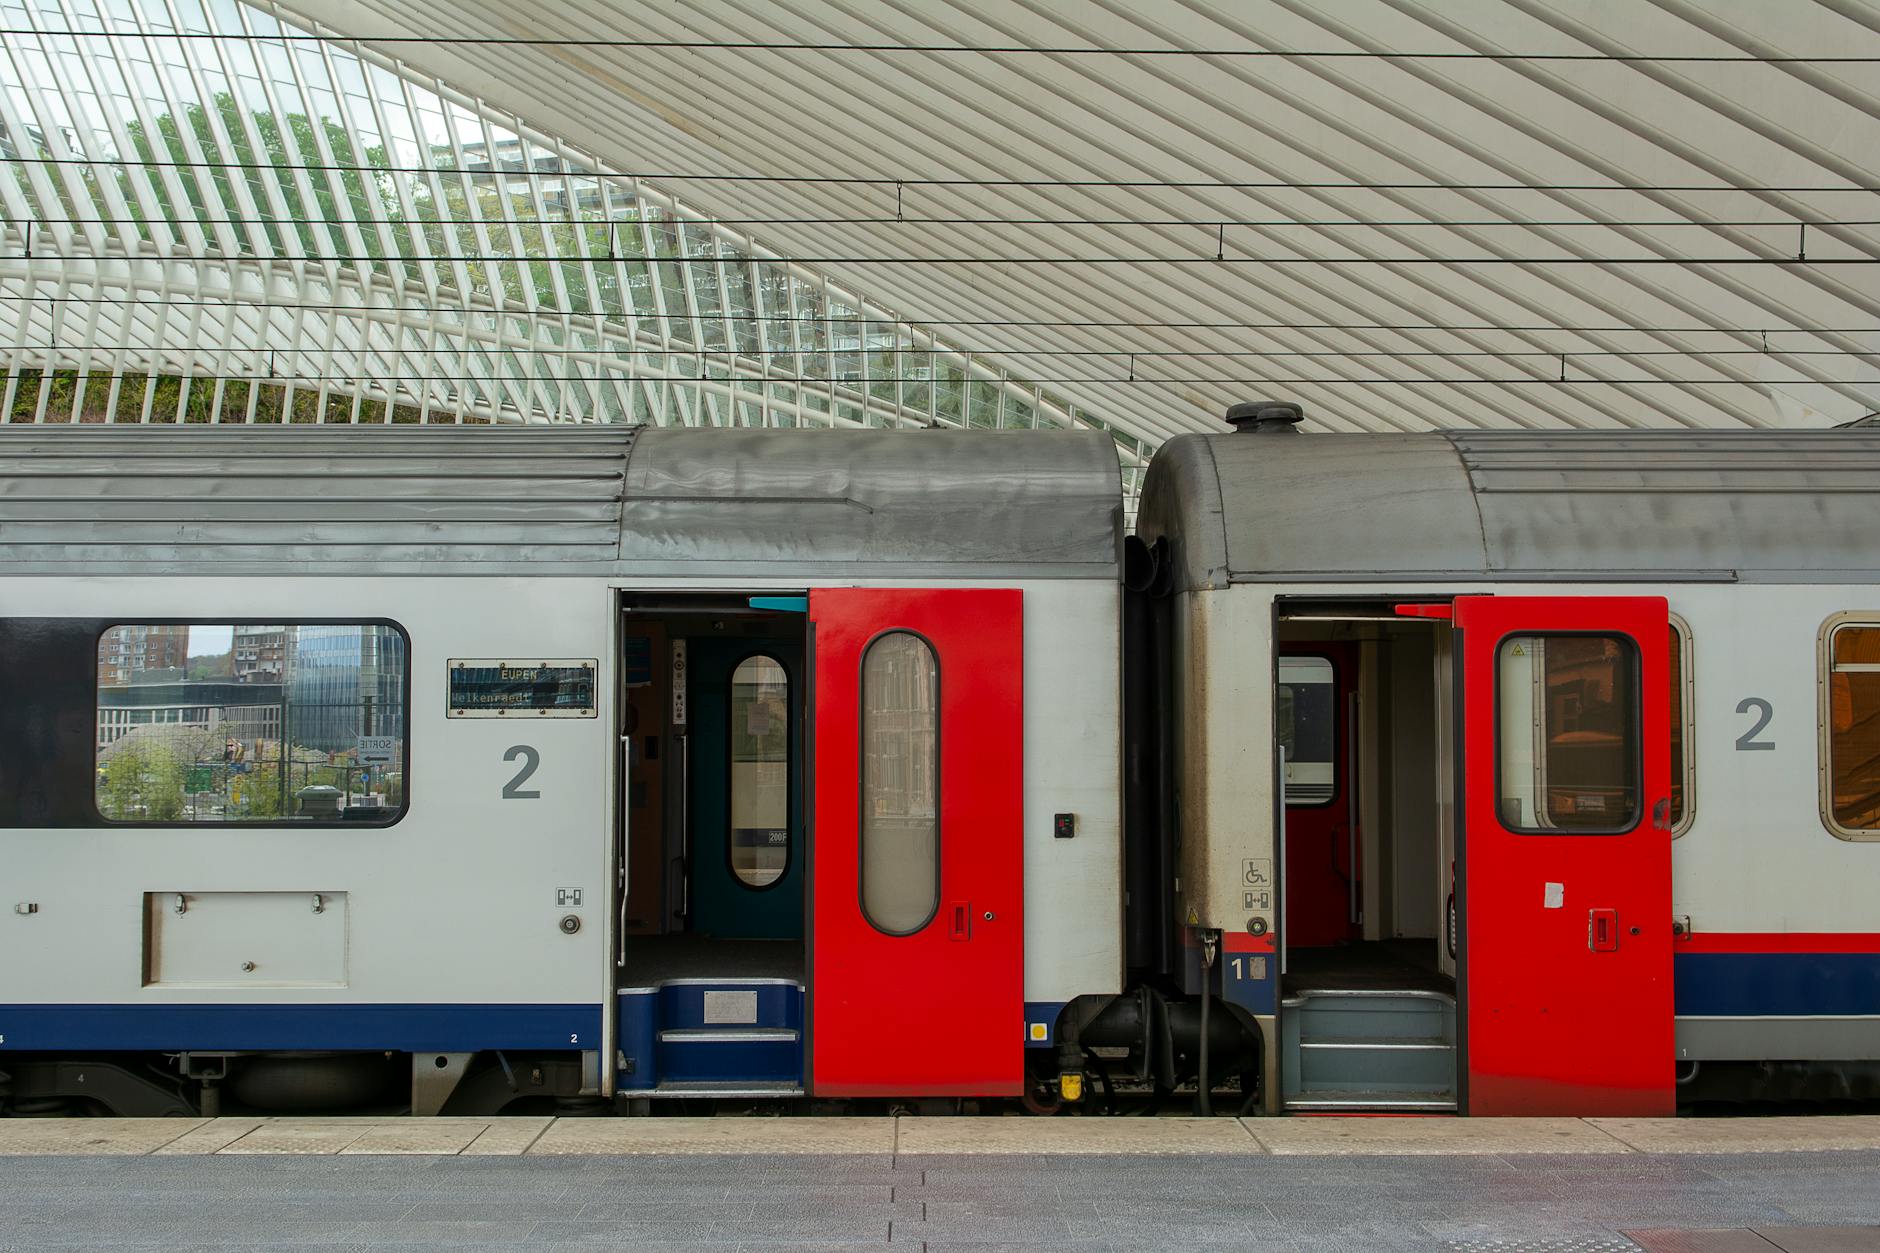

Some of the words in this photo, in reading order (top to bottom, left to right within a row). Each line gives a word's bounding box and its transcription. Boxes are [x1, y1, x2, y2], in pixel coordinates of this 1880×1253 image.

[501, 670, 538, 680] EUPEN
[1735, 697, 1776, 751] 2
[502, 744, 541, 799] 2
[1231, 958, 1242, 980] 1
[570, 1033, 578, 1043] 2
[1682, 1047, 1687, 1057] 1
